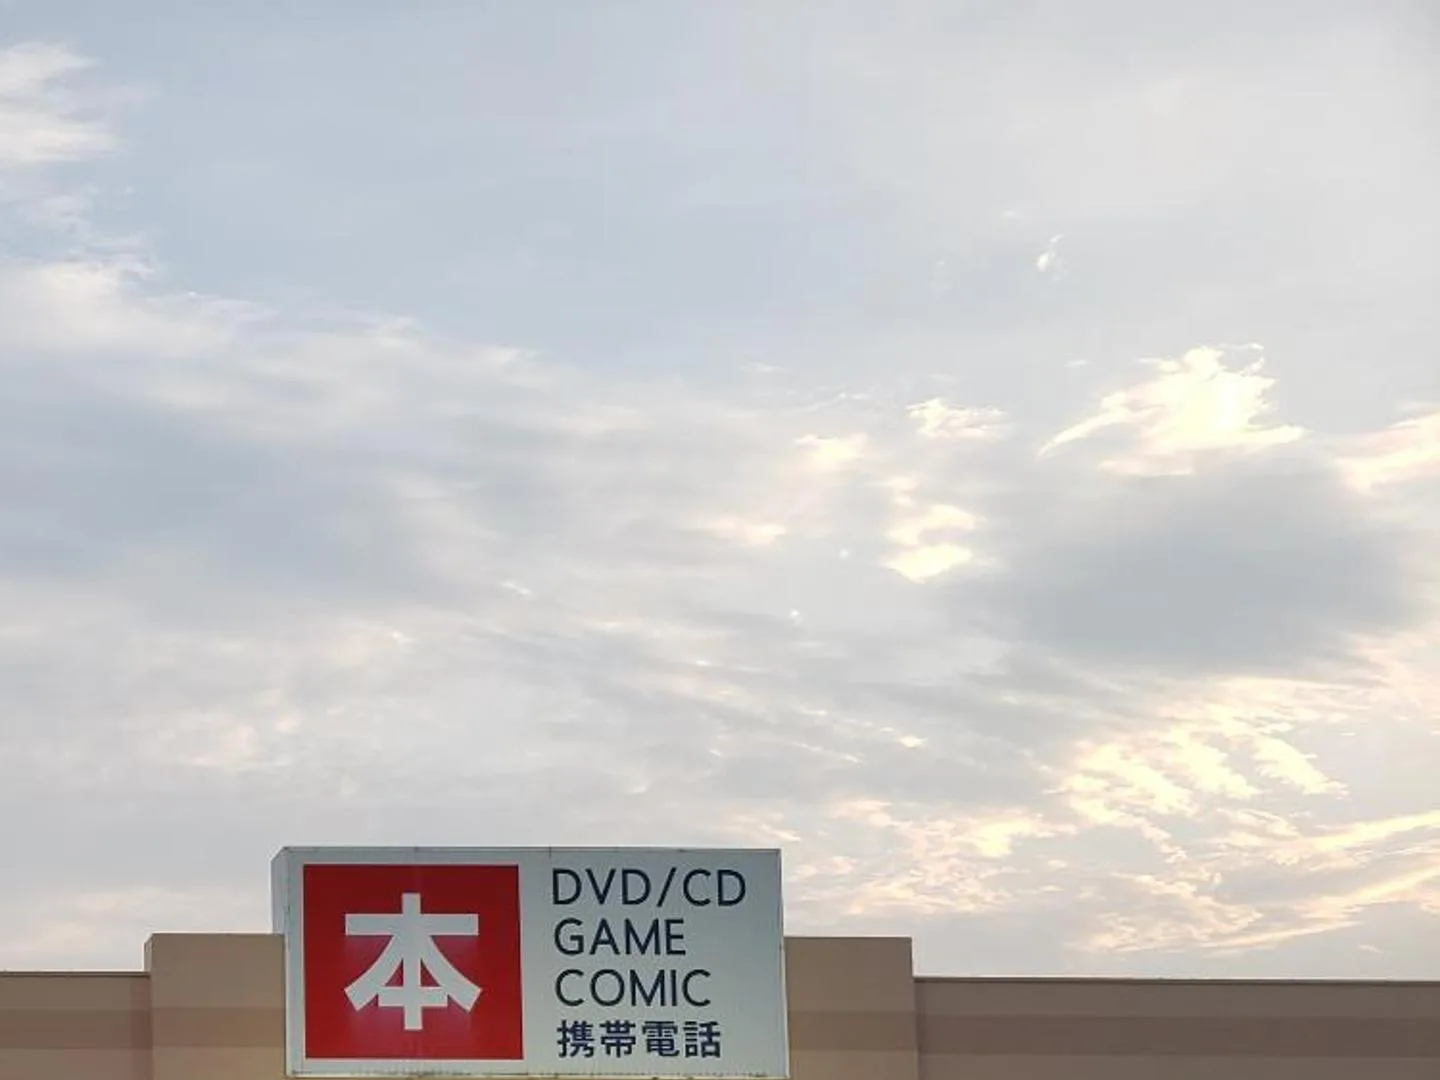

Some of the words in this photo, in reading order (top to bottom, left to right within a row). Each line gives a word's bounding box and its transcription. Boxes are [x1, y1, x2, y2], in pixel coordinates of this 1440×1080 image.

[551, 868, 747, 908] DVD/CD
[553, 918, 687, 956] GAME
[344, 892, 483, 1031] 本
[555, 969, 712, 1007] COMIC
[556, 1020, 722, 1060] 携帯電話
